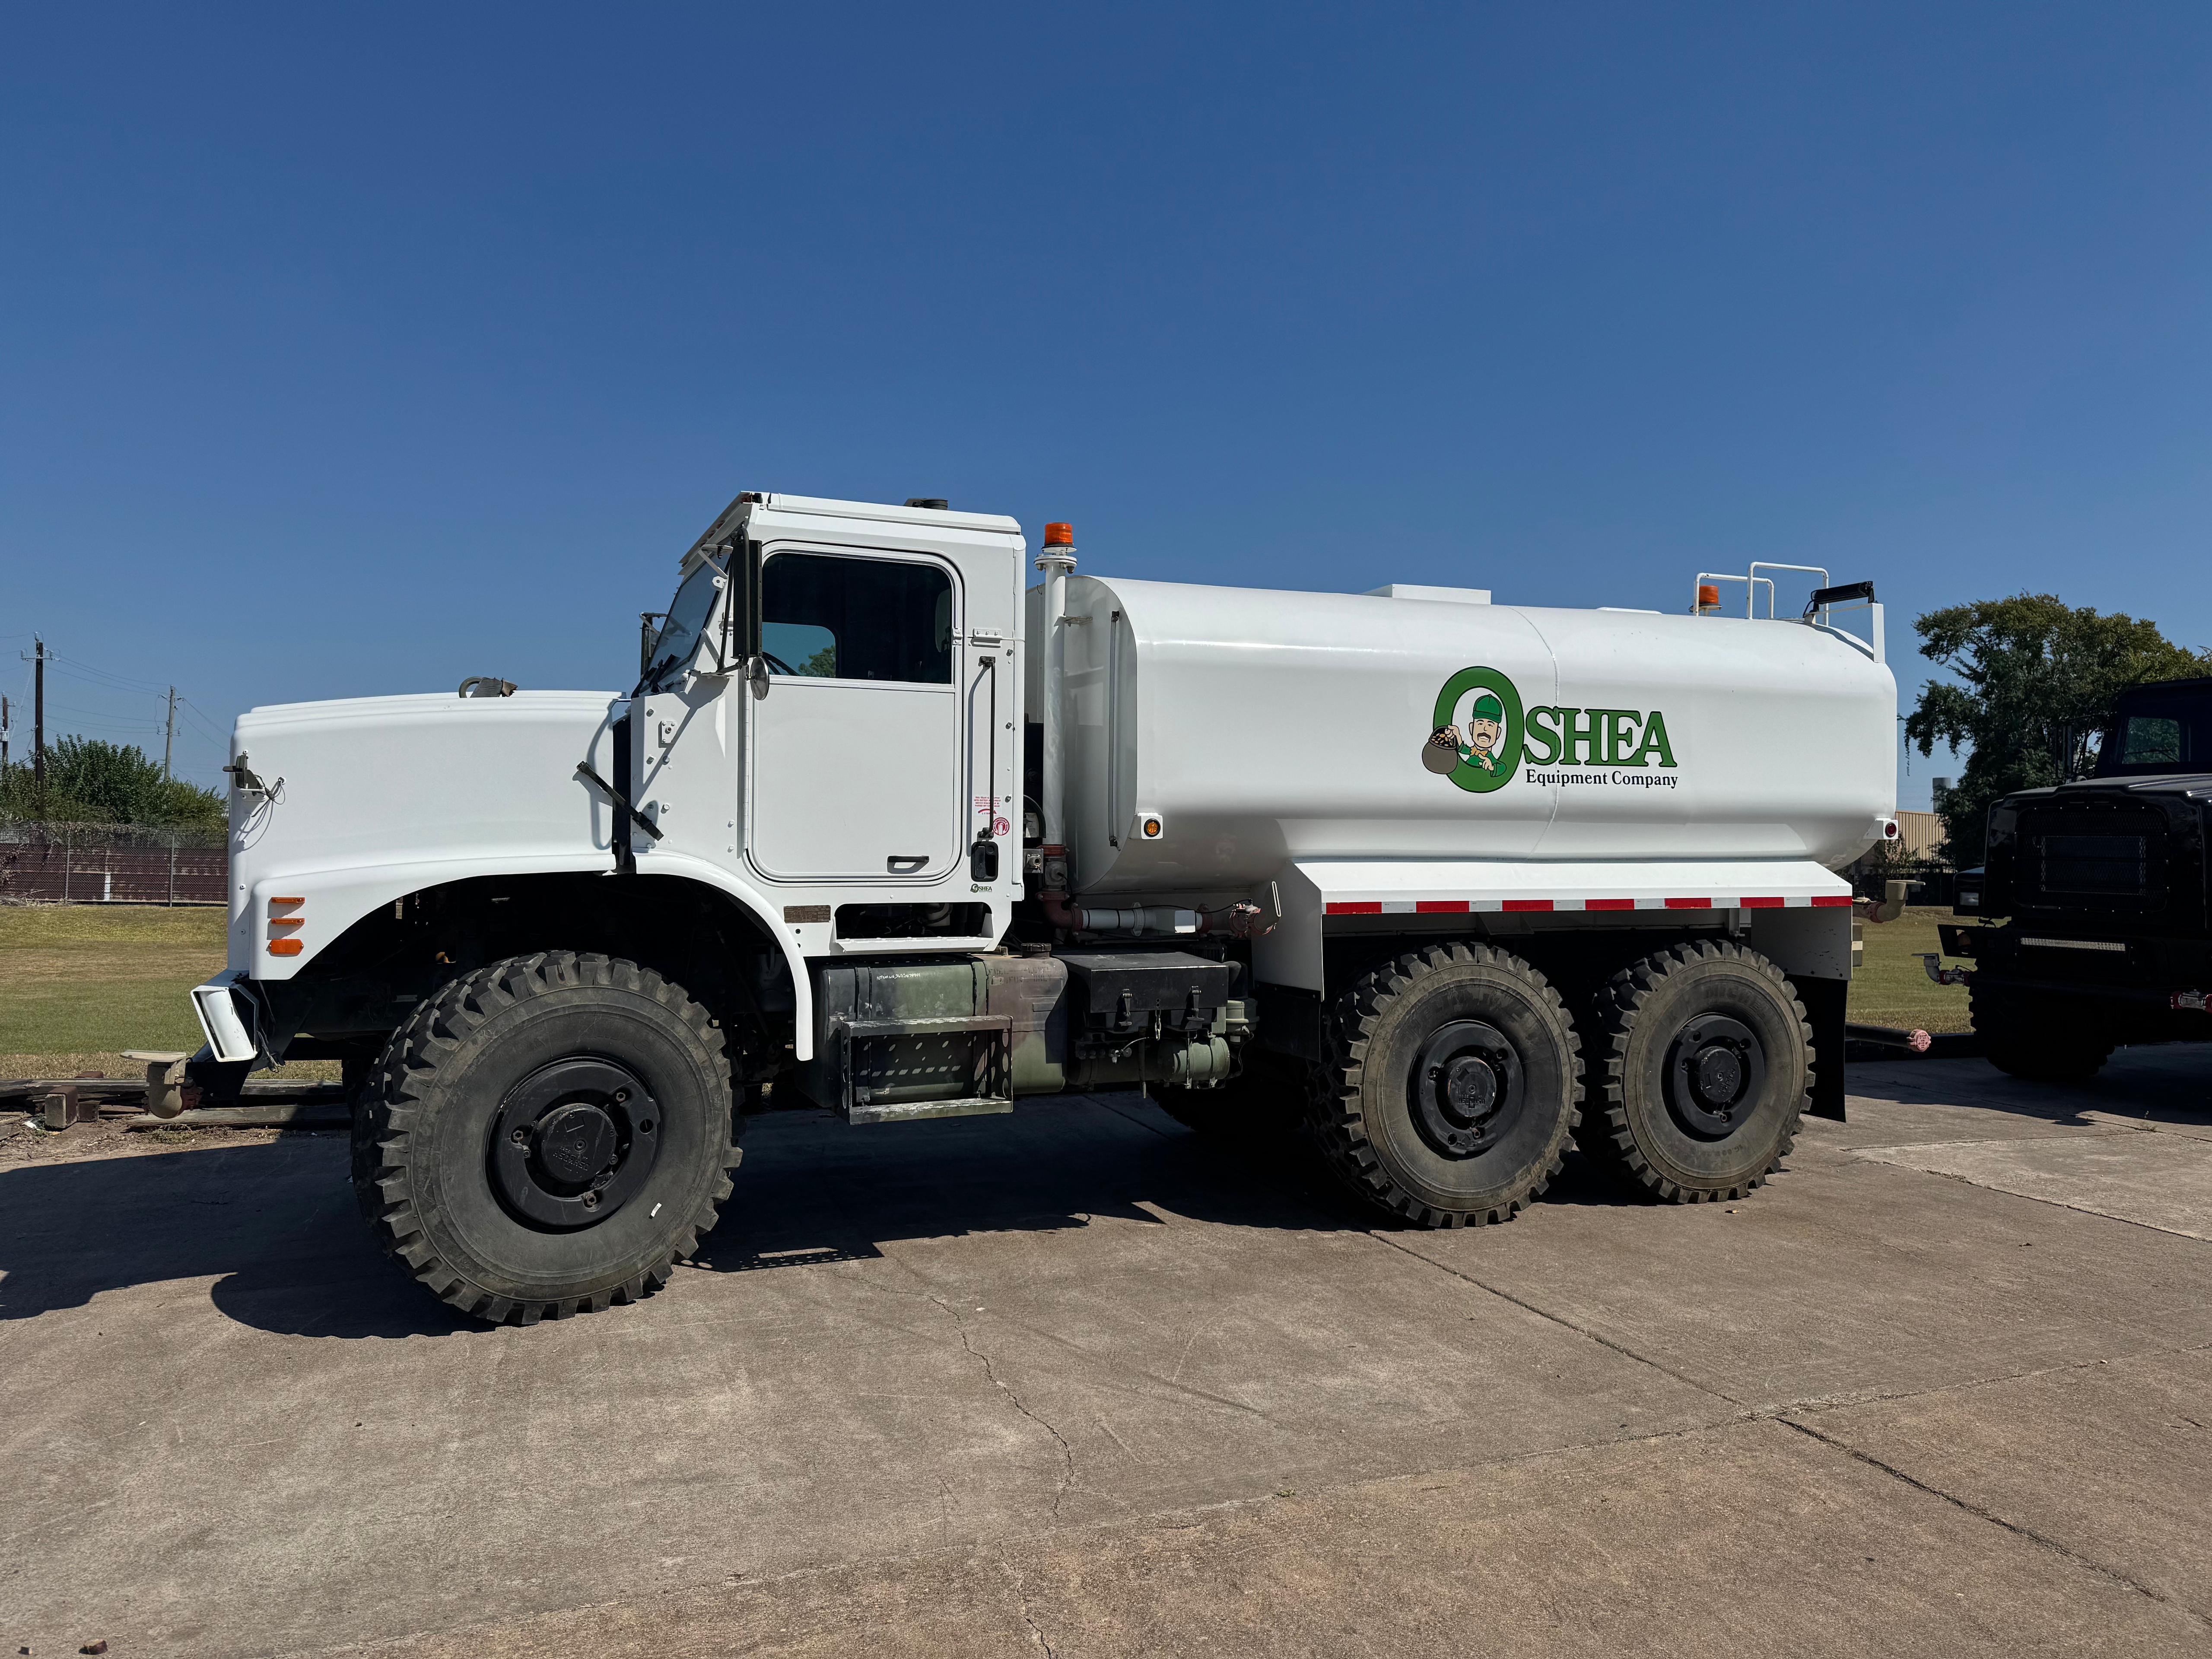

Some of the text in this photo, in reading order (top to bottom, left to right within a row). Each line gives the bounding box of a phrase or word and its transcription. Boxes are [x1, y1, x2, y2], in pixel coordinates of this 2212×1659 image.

[1433, 666, 1678, 793] OSHEA
[1526, 769, 1678, 788] Equipment Company
